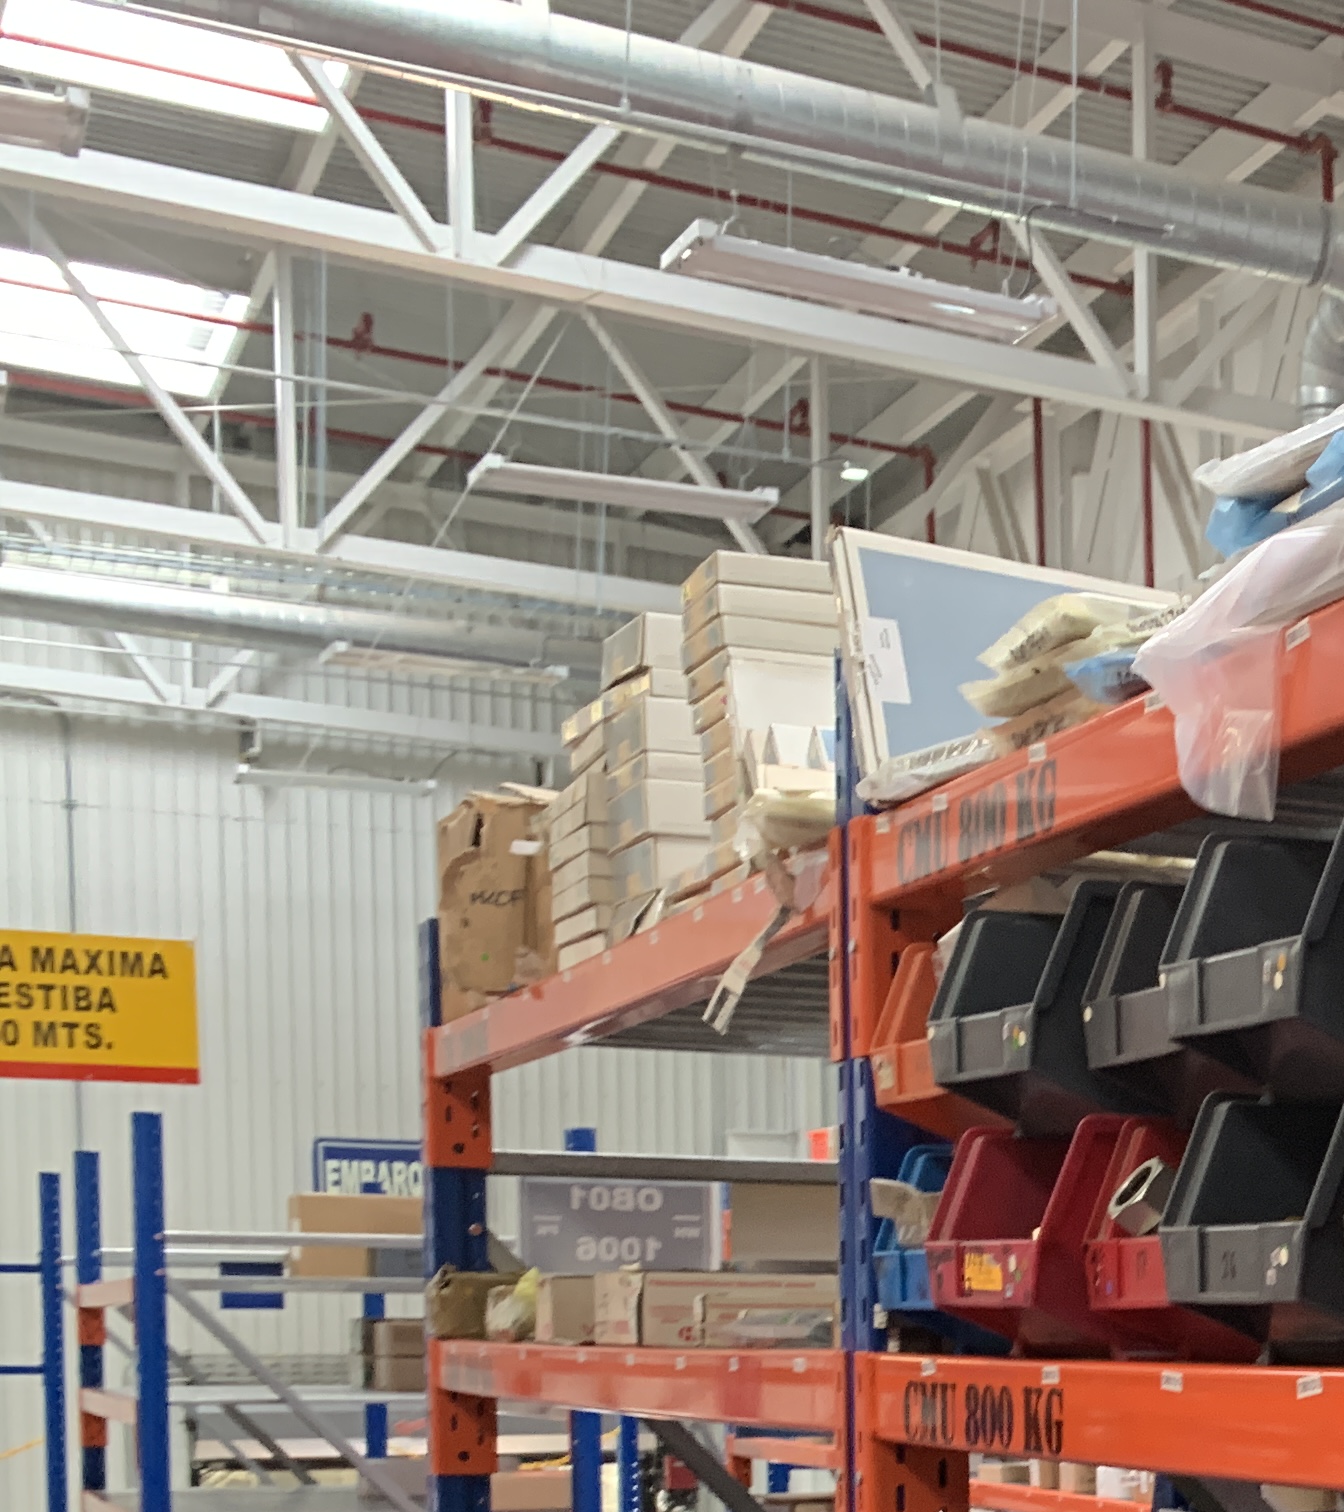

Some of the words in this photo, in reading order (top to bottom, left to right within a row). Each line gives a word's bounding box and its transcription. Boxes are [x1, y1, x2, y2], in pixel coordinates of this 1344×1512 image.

[30, 945, 169, 980] MAXIMA
[0, 982, 118, 1014] ESTIBA
[32, 1020, 114, 1050] MTS.
[903, 1379, 957, 1445] CMU
[964, 1382, 1014, 1450] 800
[1023, 1386, 1064, 1456] KG
